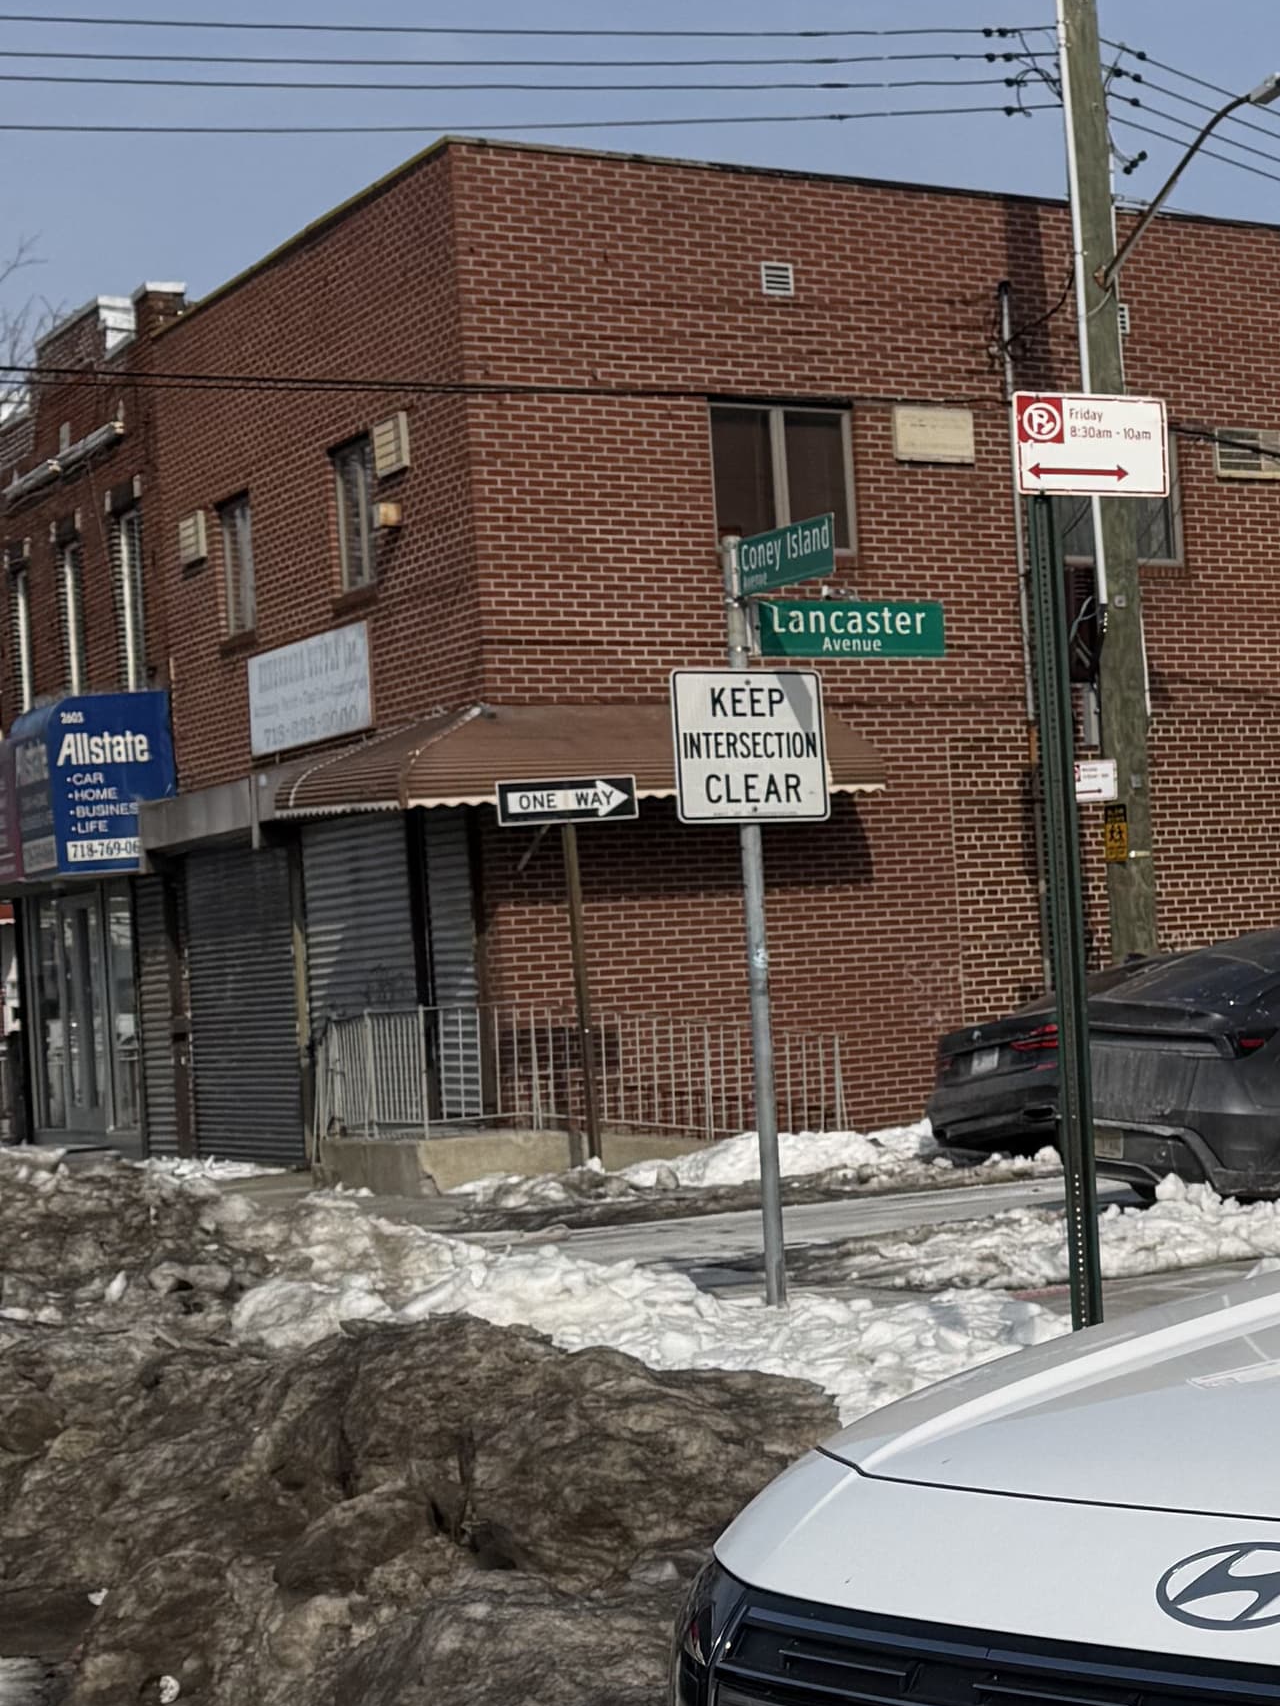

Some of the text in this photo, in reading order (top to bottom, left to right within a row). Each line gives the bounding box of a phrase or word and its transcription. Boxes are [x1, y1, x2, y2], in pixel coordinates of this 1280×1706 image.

[1069, 408, 1103, 423] Friday
[1070, 425, 1112, 439] 8:30am
[1123, 428, 1151, 441] 10am
[741, 519, 830, 572] Coney Island
[743, 571, 768, 589] Avenue
[772, 605, 926, 635] Lancaster
[822, 636, 882, 652] Avenue
[710, 687, 785, 718] KEEP
[56, 730, 151, 766] Allstate
[683, 732, 818, 760] INTERSECTION
[73, 772, 104, 784] CAR
[74, 787, 118, 801] HOME
[705, 773, 802, 804] CLEAR
[519, 790, 614, 810] ONE WAY
[76, 803, 139, 818] BUSINES
[78, 820, 108, 833] LIFE
